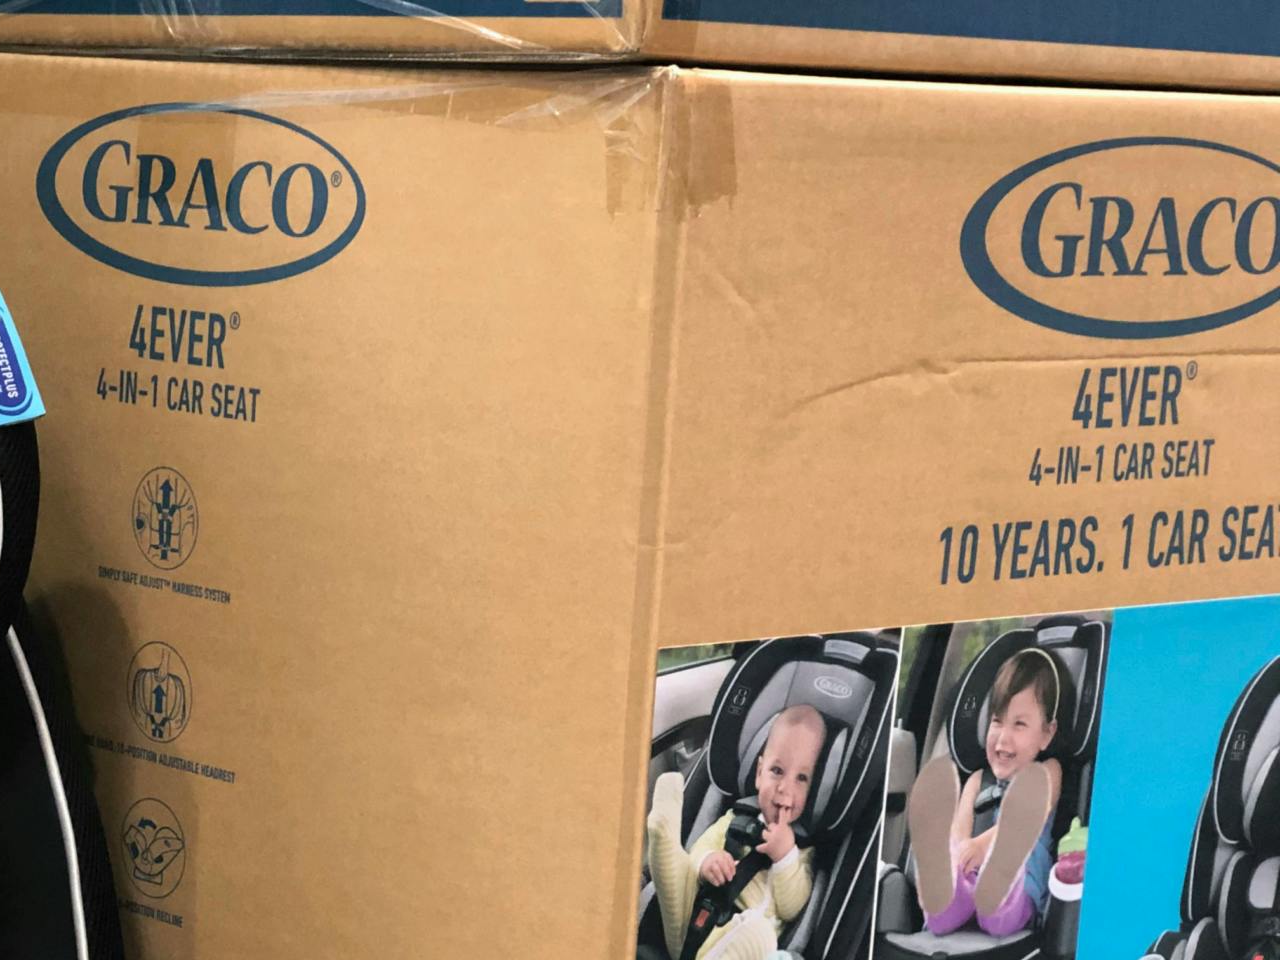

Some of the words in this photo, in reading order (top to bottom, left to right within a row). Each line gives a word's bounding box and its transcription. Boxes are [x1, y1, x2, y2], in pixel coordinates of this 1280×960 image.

[1021, 182, 1280, 278] GRACO
[97, 368, 159, 408] 4-IN-1
[167, 377, 203, 414] CAR
[210, 384, 261, 423] SEAT
[1029, 445, 1105, 486] 4-IN-1
[1113, 442, 1155, 482] CAR
[1161, 439, 1215, 479] SEAT
[940, 524, 980, 585] 10
[993, 516, 1104, 581] YEARS.
[1122, 514, 1134, 570] 1
[1147, 509, 1209, 568] CAR
